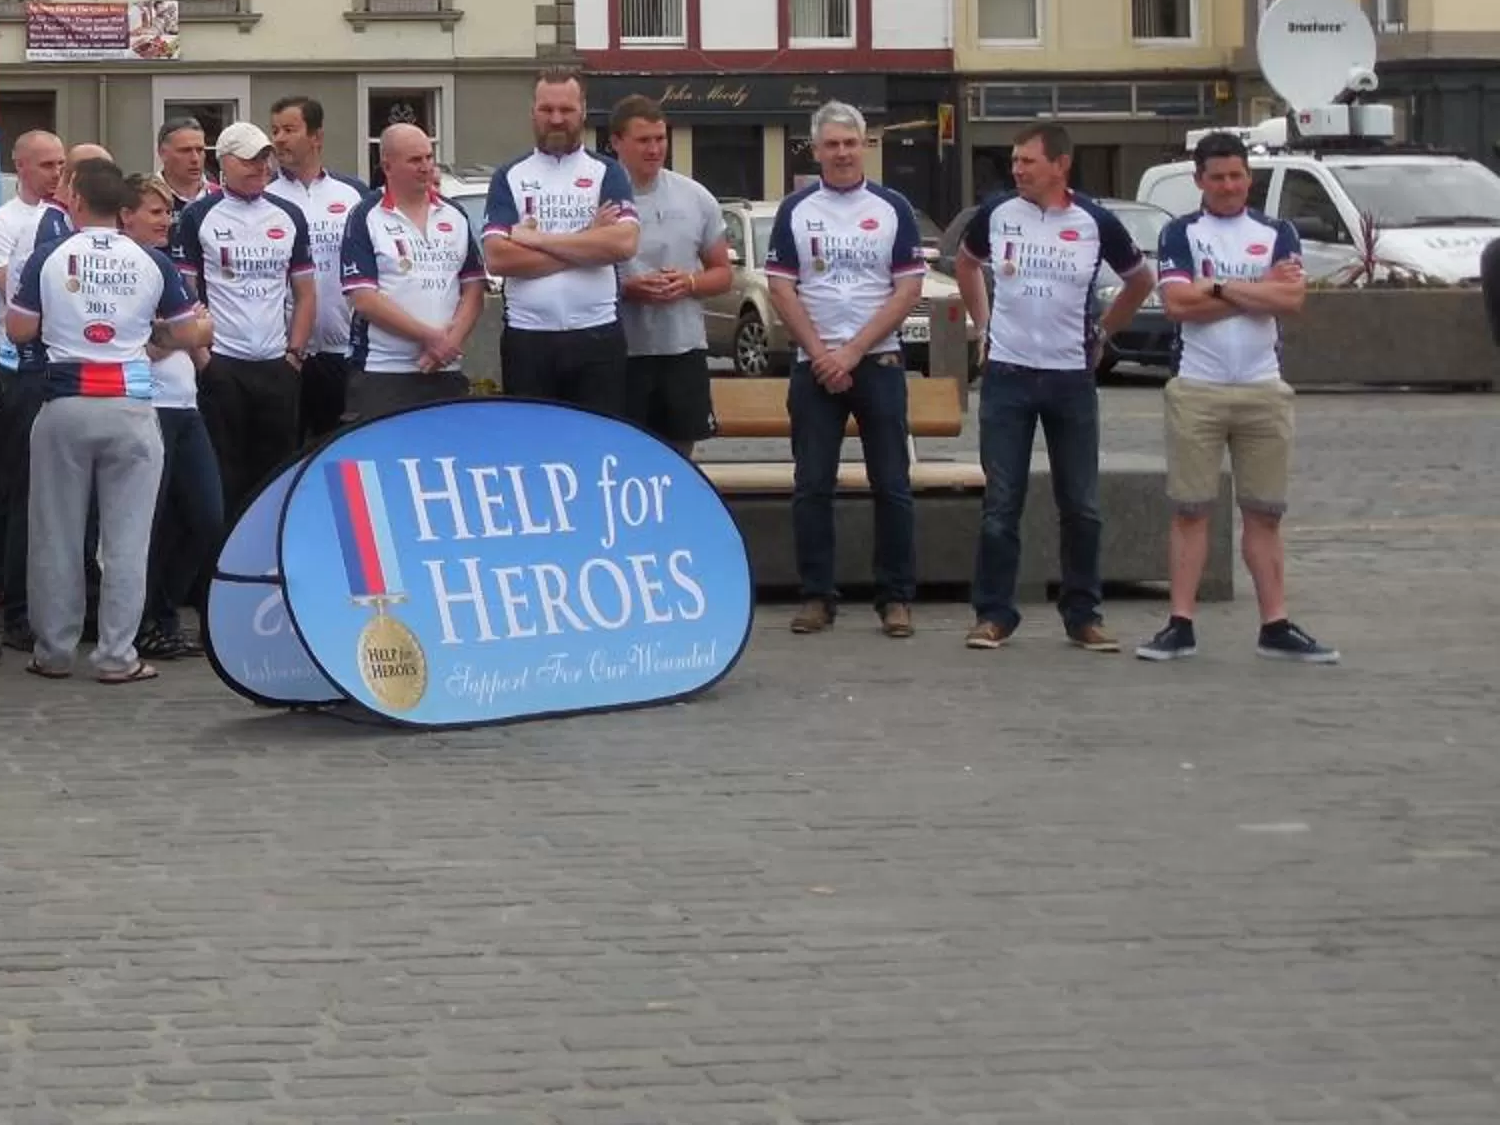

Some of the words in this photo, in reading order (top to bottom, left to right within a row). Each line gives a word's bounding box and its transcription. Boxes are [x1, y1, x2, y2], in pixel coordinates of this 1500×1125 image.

[83, 270, 138, 284] HEROES
[86, 301, 117, 314] 2015
[399, 456, 578, 542] HELP
[597, 454, 672, 548] for
[421, 549, 706, 646] HEROES
[367, 648, 397, 662] HELP
[371, 664, 417, 679] HEROES
[445, 663, 528, 707] Support
